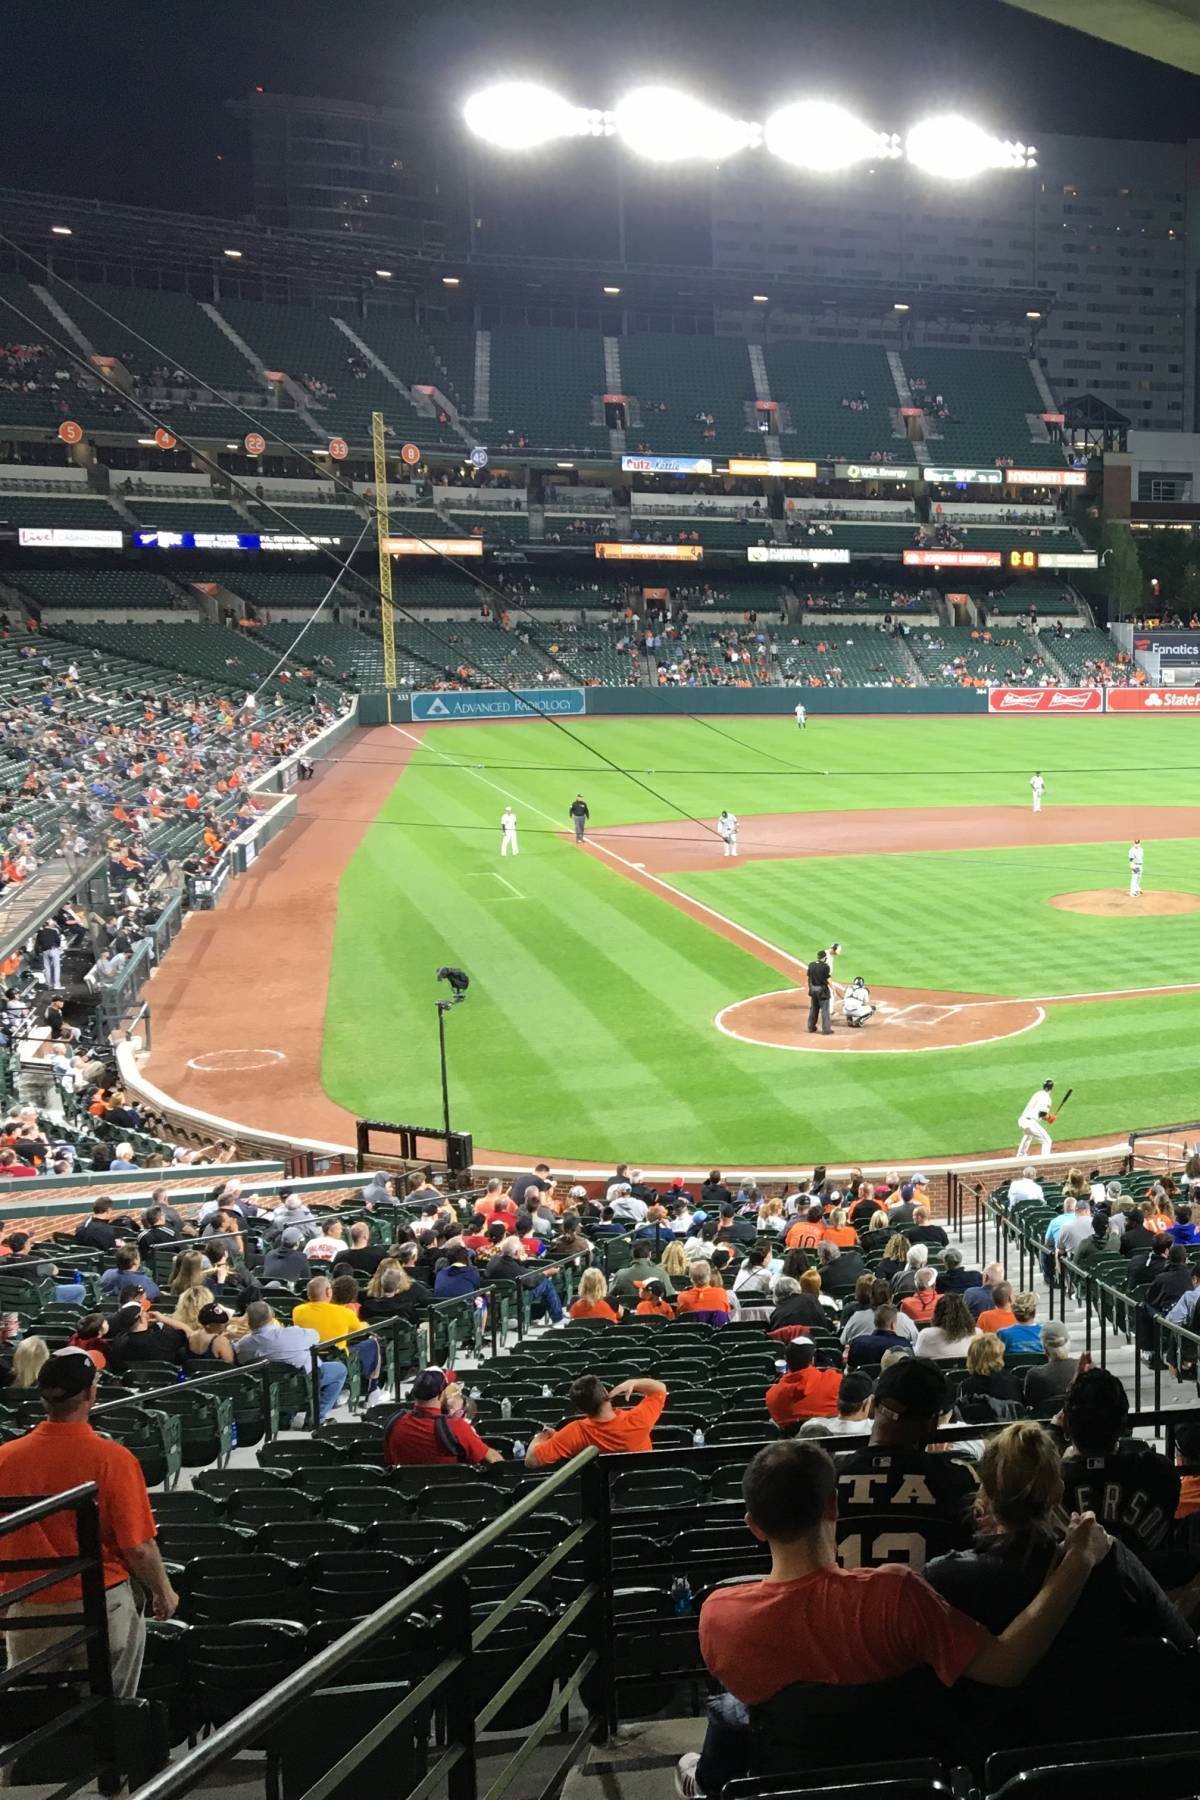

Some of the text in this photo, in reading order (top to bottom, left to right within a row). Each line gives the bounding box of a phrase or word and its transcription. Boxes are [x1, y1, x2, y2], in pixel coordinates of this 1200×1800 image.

[66, 426, 75, 438] 5
[161, 432, 169, 444] 4
[248, 438, 263, 449] 22
[332, 444, 346, 455] 33
[473, 453, 486, 463] 42
[1153, 643, 1199, 656] Fanatics
